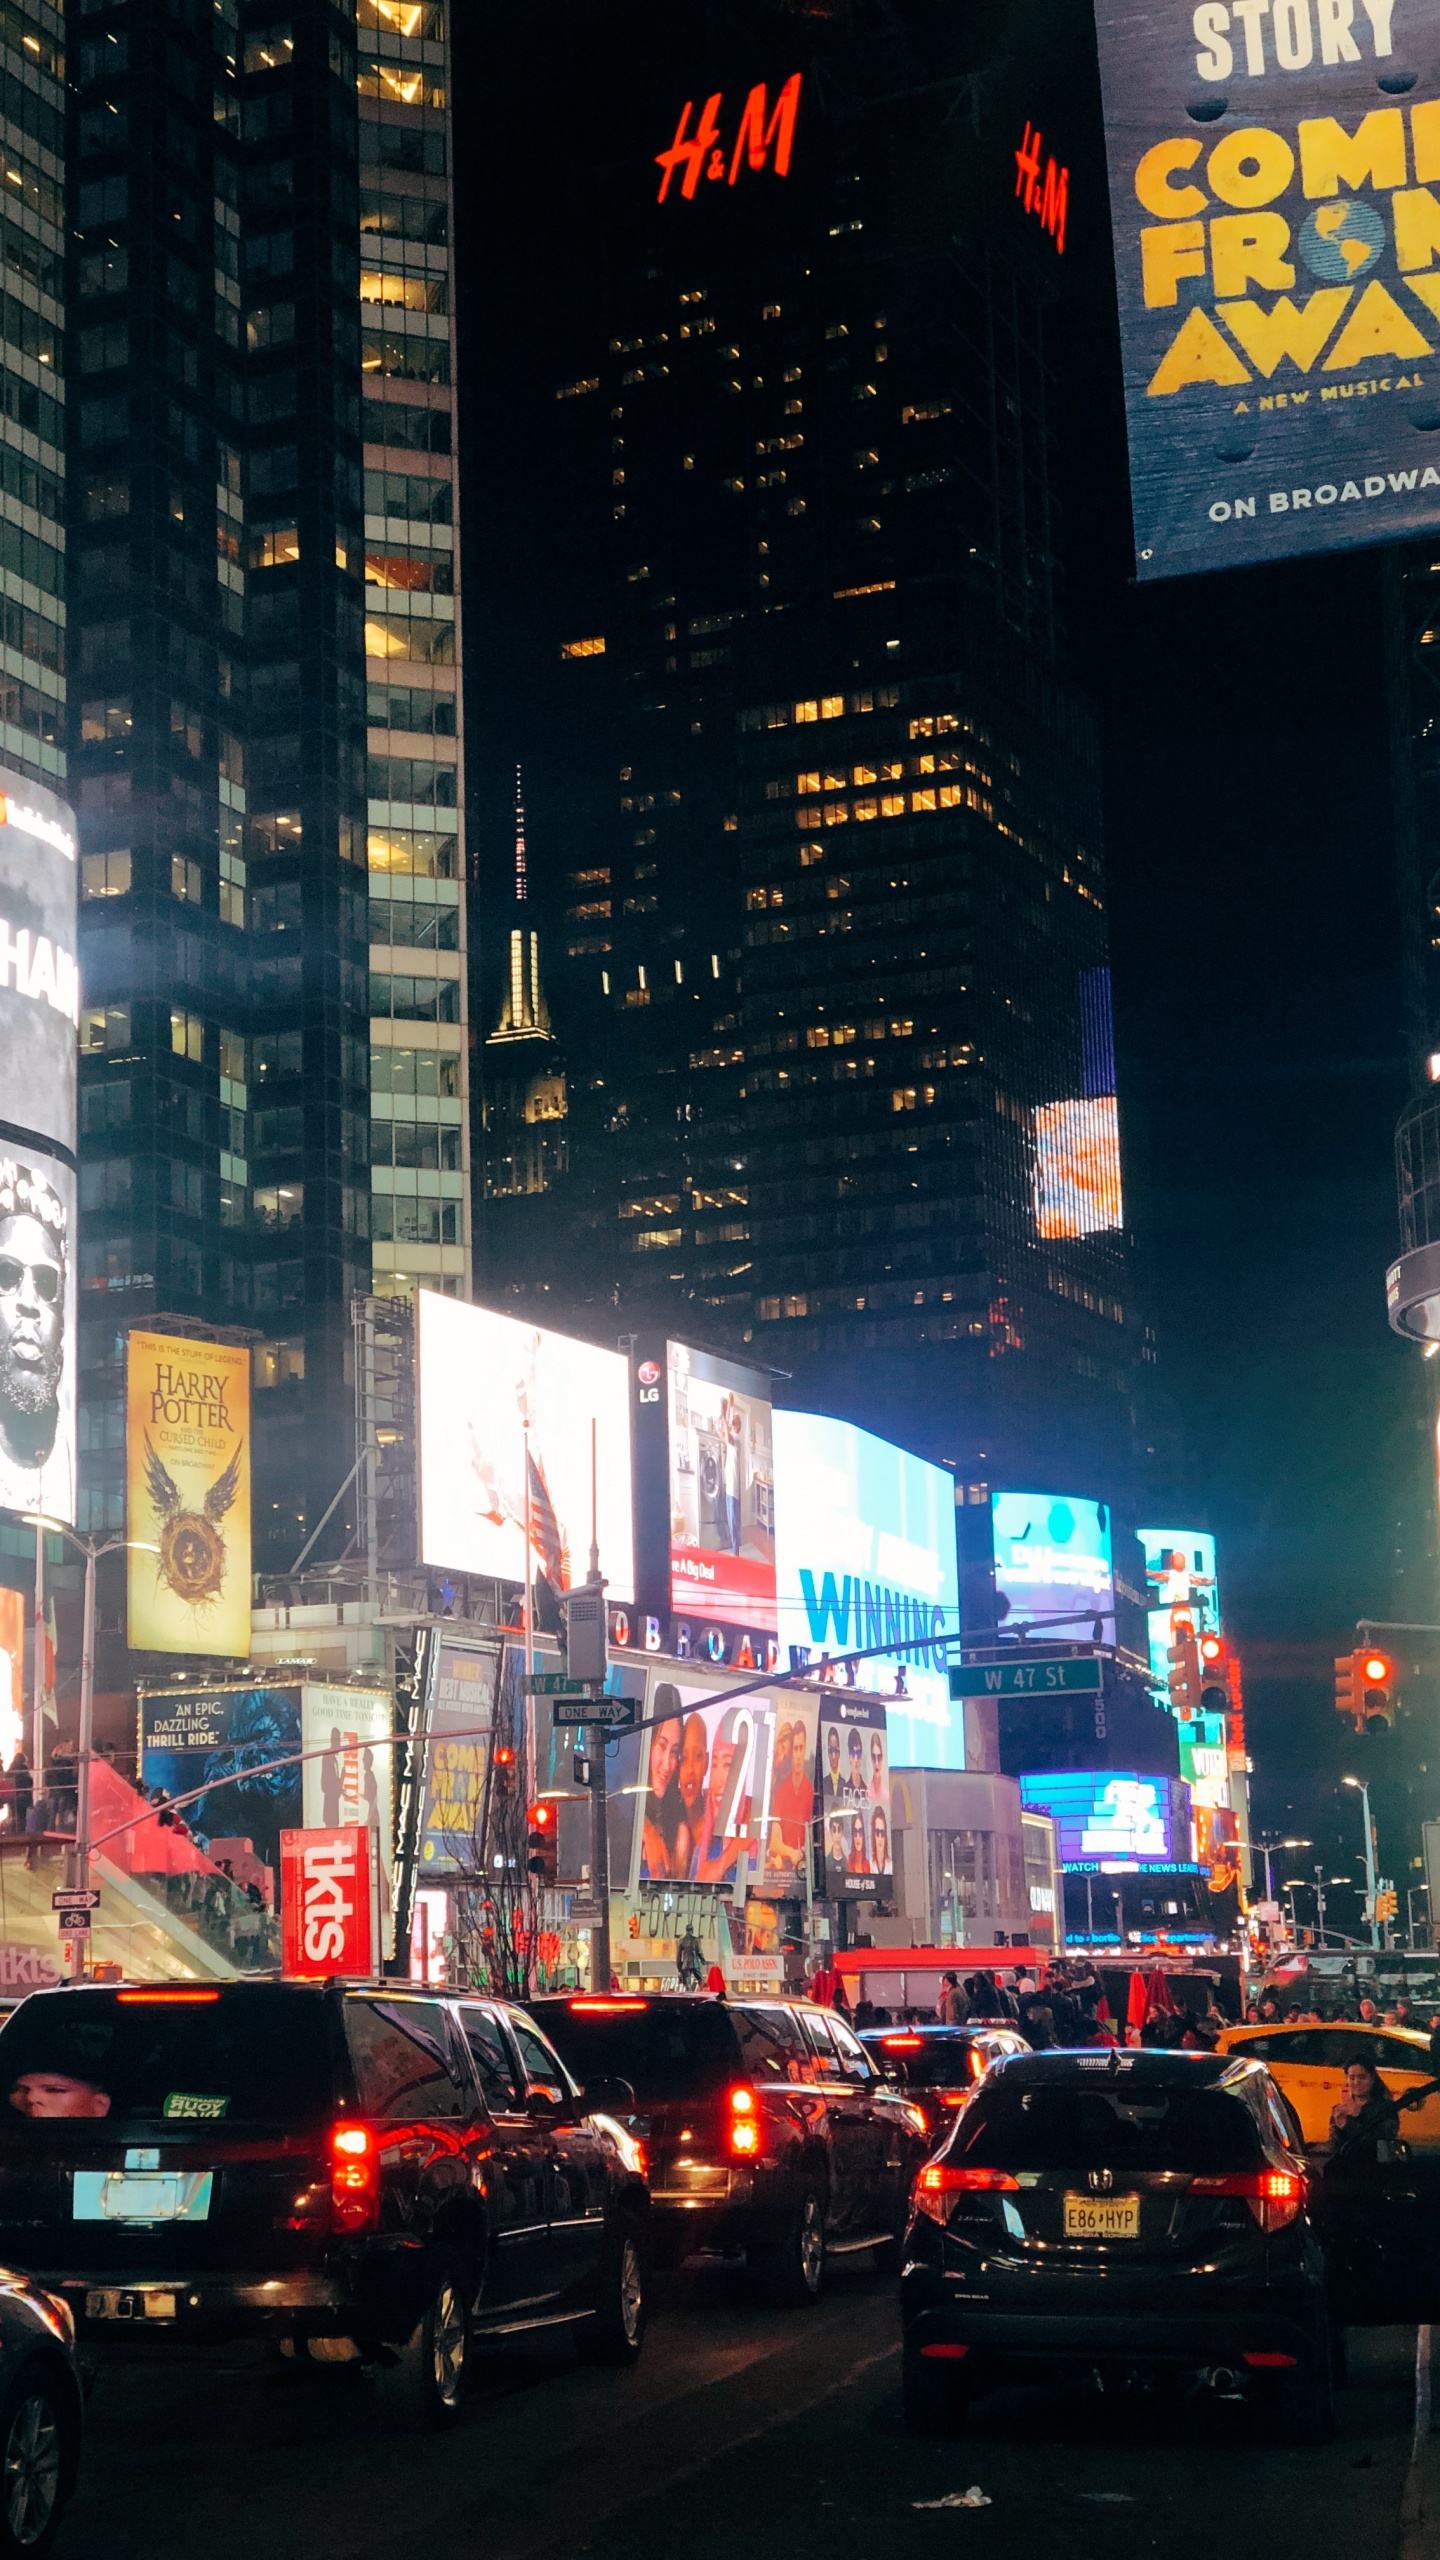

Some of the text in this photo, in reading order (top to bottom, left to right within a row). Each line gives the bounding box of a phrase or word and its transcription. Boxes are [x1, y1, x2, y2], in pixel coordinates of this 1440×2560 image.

[1193, 0, 1396, 82] STORY
[654, 72, 802, 203] H&M
[1015, 120, 1069, 255] H&M
[1233, 373, 1424, 415] A NEW MUSICAL
[1208, 496, 1257, 522] ON
[167, 1345, 180, 1356] THE
[181, 1348, 203, 1359] STUFF
[155, 1362, 230, 1404] HARRY
[639, 1387, 660, 1403] LG
[150, 1391, 235, 1433] POTTER
[159, 1430, 226, 1450] CURSED CHILD
[687, 1559, 699, 1581] Big
[699, 1562, 715, 1581] Deal
[798, 1568, 948, 1675] WINNING
[277, 1657, 315, 1665] LAMAR
[534, 1675, 569, 1693] W 47
[984, 1665, 1066, 1690] W 47 St
[322, 1694, 340, 1706] HAVE
[349, 1697, 375, 1710] REALLY
[312, 1706, 334, 1718] GOOD
[335, 1708, 353, 1721] TIME
[564, 1707, 622, 1718] ONE WAY
[153, 1717, 210, 1733] DAZZLING
[147, 1733, 185, 1748] THRILL
[433, 1742, 486, 1775] COME
[722, 1707, 777, 1840] 21
[842, 1786, 872, 1810] FACES
[1063, 1862, 1099, 1874] WATCH
[1149, 1862, 1177, 1873] NEWS
[845, 1878, 861, 1890] HOUSE
[865, 1879, 875, 1890] SUN
[58, 1896, 93, 1905] ONE WAY
[303, 1840, 356, 1963] tkts
[75, 1929, 89, 1937] LANE
[743, 1958, 761, 1970] POLO
[1068, 2209, 1134, 2230] E86 HYP
